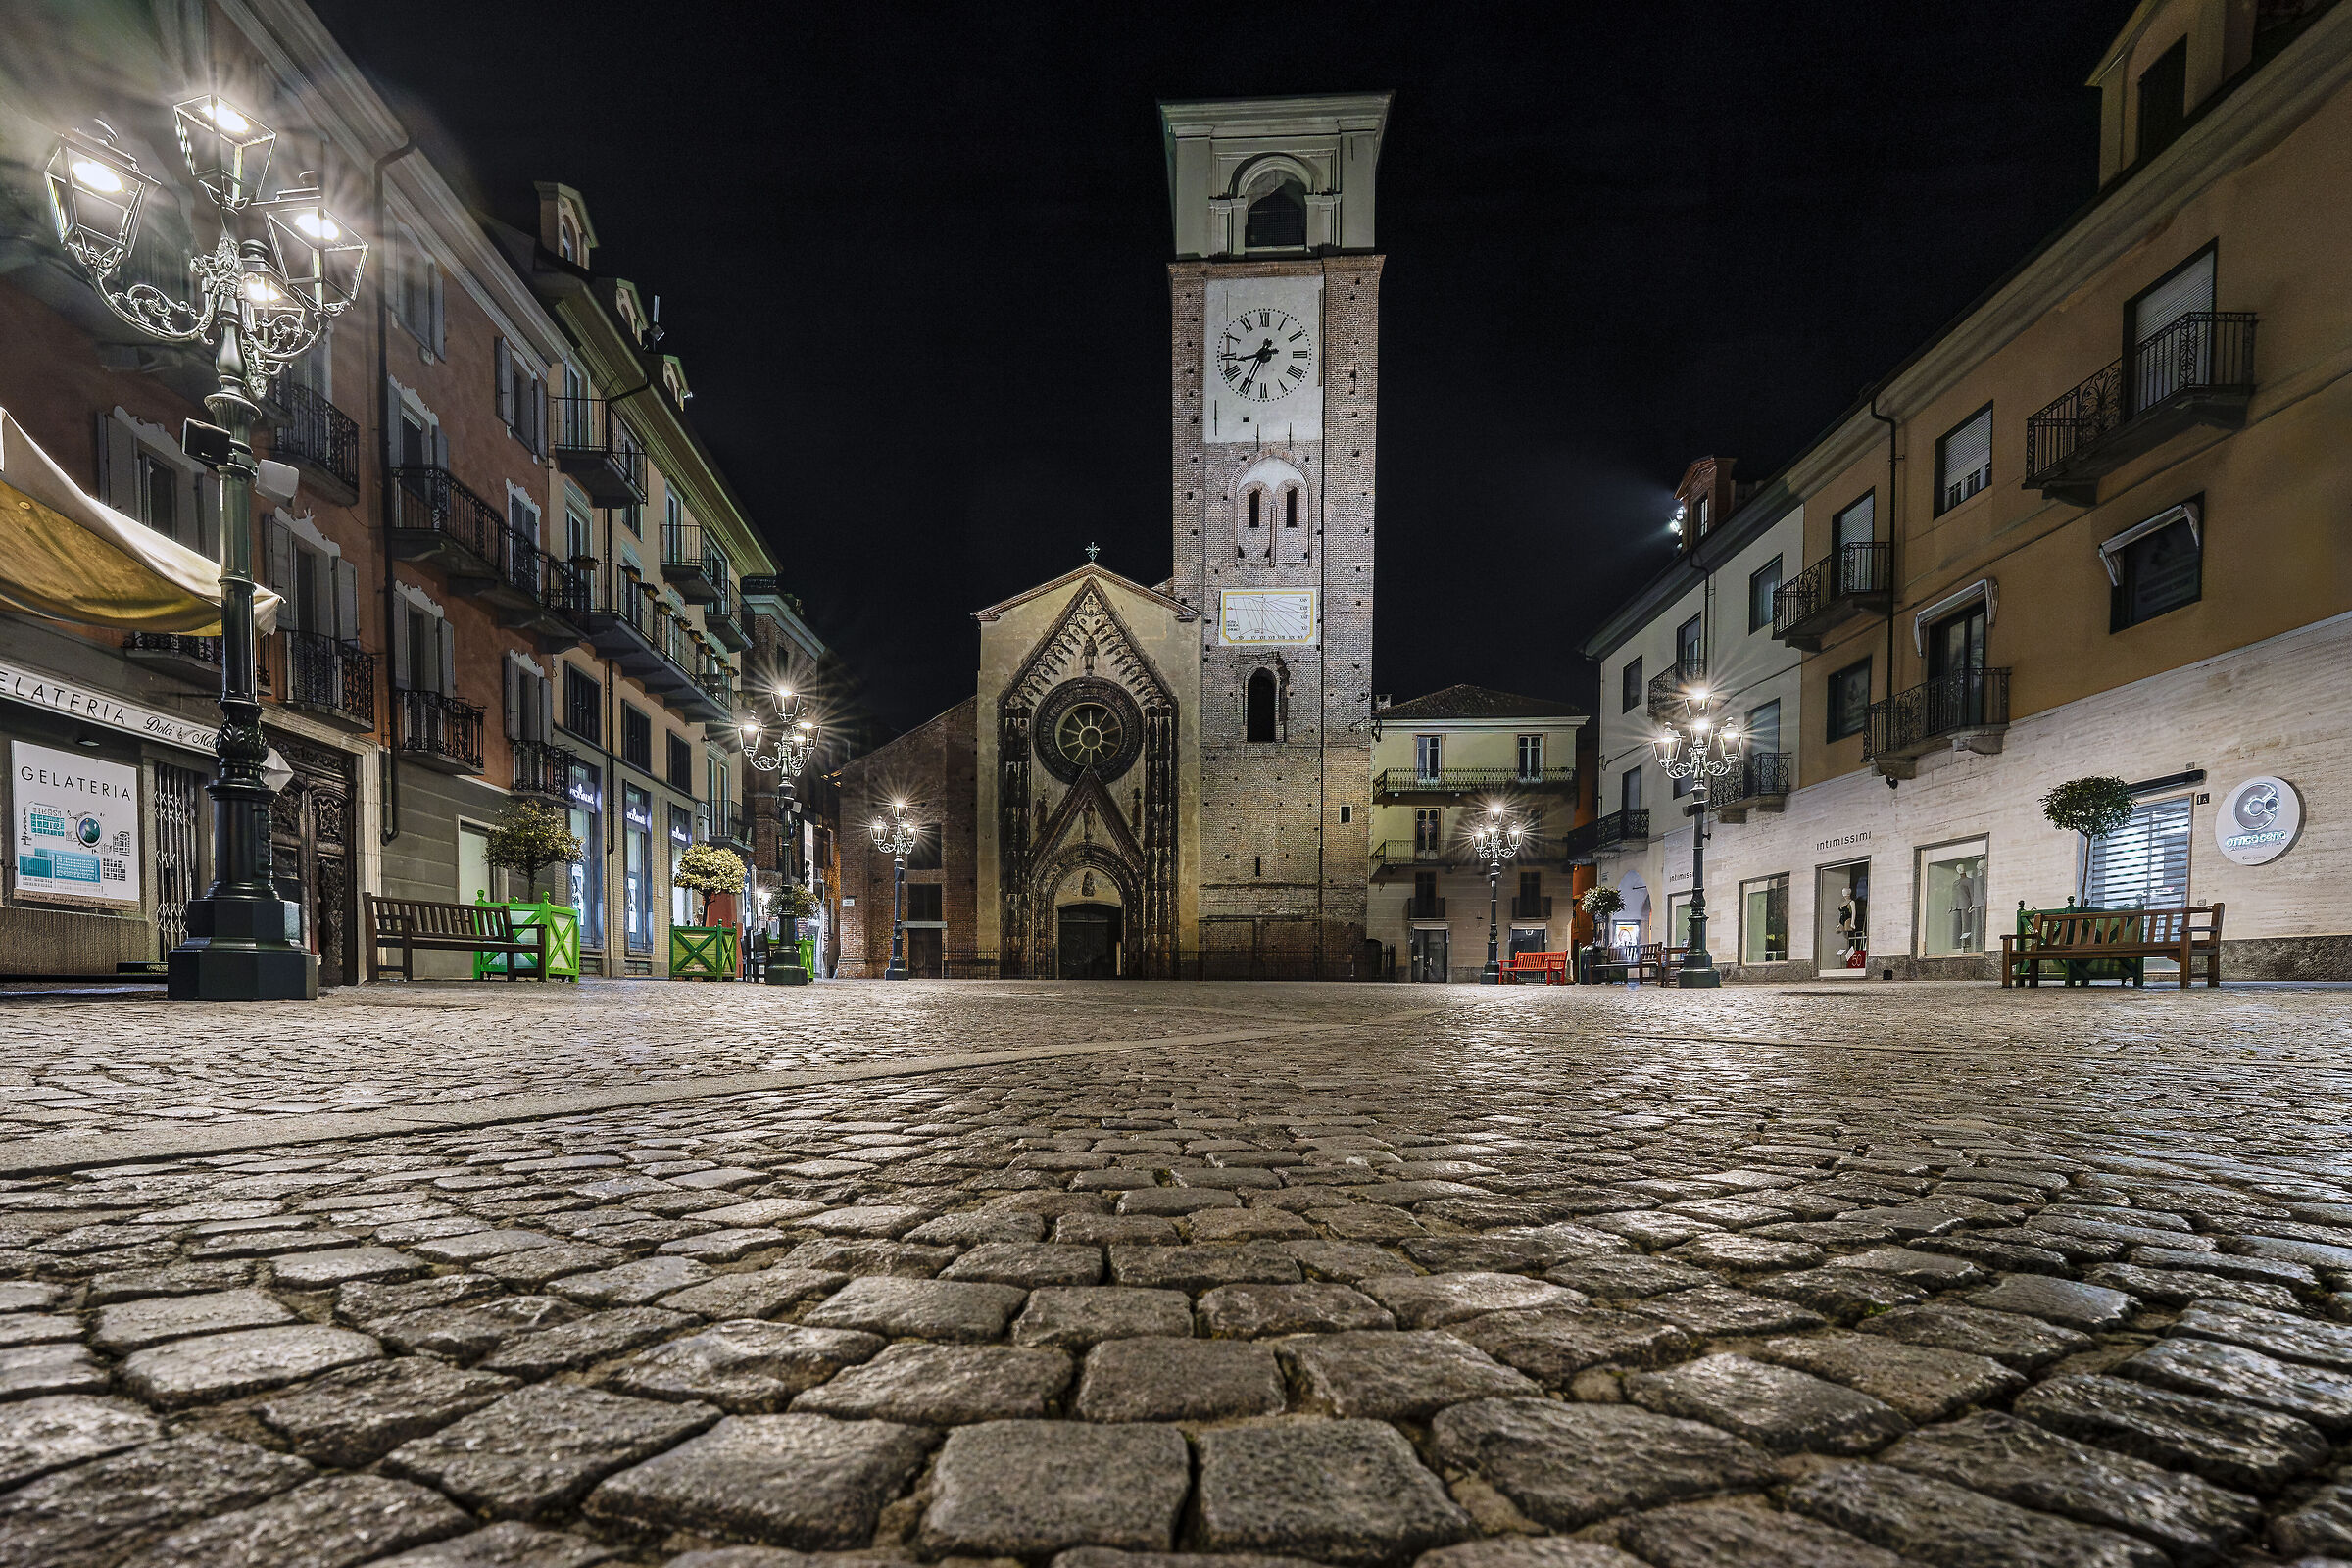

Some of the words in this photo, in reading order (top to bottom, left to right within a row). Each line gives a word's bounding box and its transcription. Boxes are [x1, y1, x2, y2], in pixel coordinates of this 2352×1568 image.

[0, 671, 125, 725] ELATERIA
[143, 716, 174, 736] Dolci
[21, 766, 131, 801] GELATERIA
[1816, 830, 1872, 851] intimissimi
[1851, 954, 1863, 967] 50
